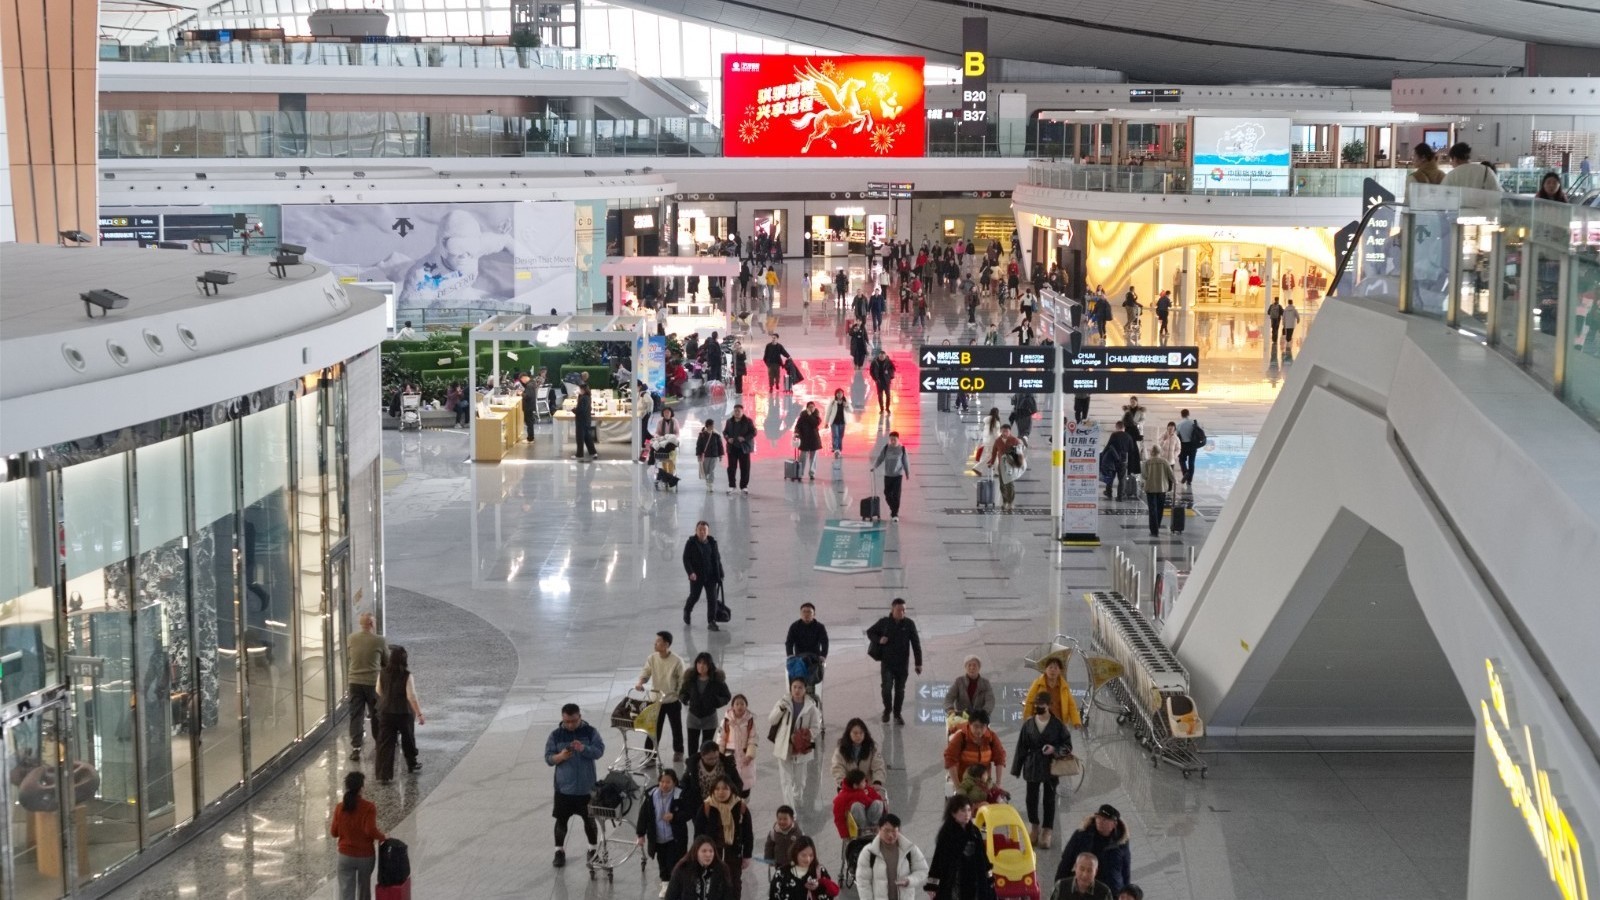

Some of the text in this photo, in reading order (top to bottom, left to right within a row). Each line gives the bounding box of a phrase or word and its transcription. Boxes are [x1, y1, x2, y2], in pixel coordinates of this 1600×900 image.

[965, 52, 985, 76] B
[964, 91, 986, 102] B20
[963, 110, 986, 121] B37
[514, 256, 537, 265] Design
[554, 255, 574, 263] Moves
[937, 351, 971, 364] 候机区 B
[936, 377, 985, 391] 候机区 C,D
[1147, 378, 1181, 390] 候机区 A
